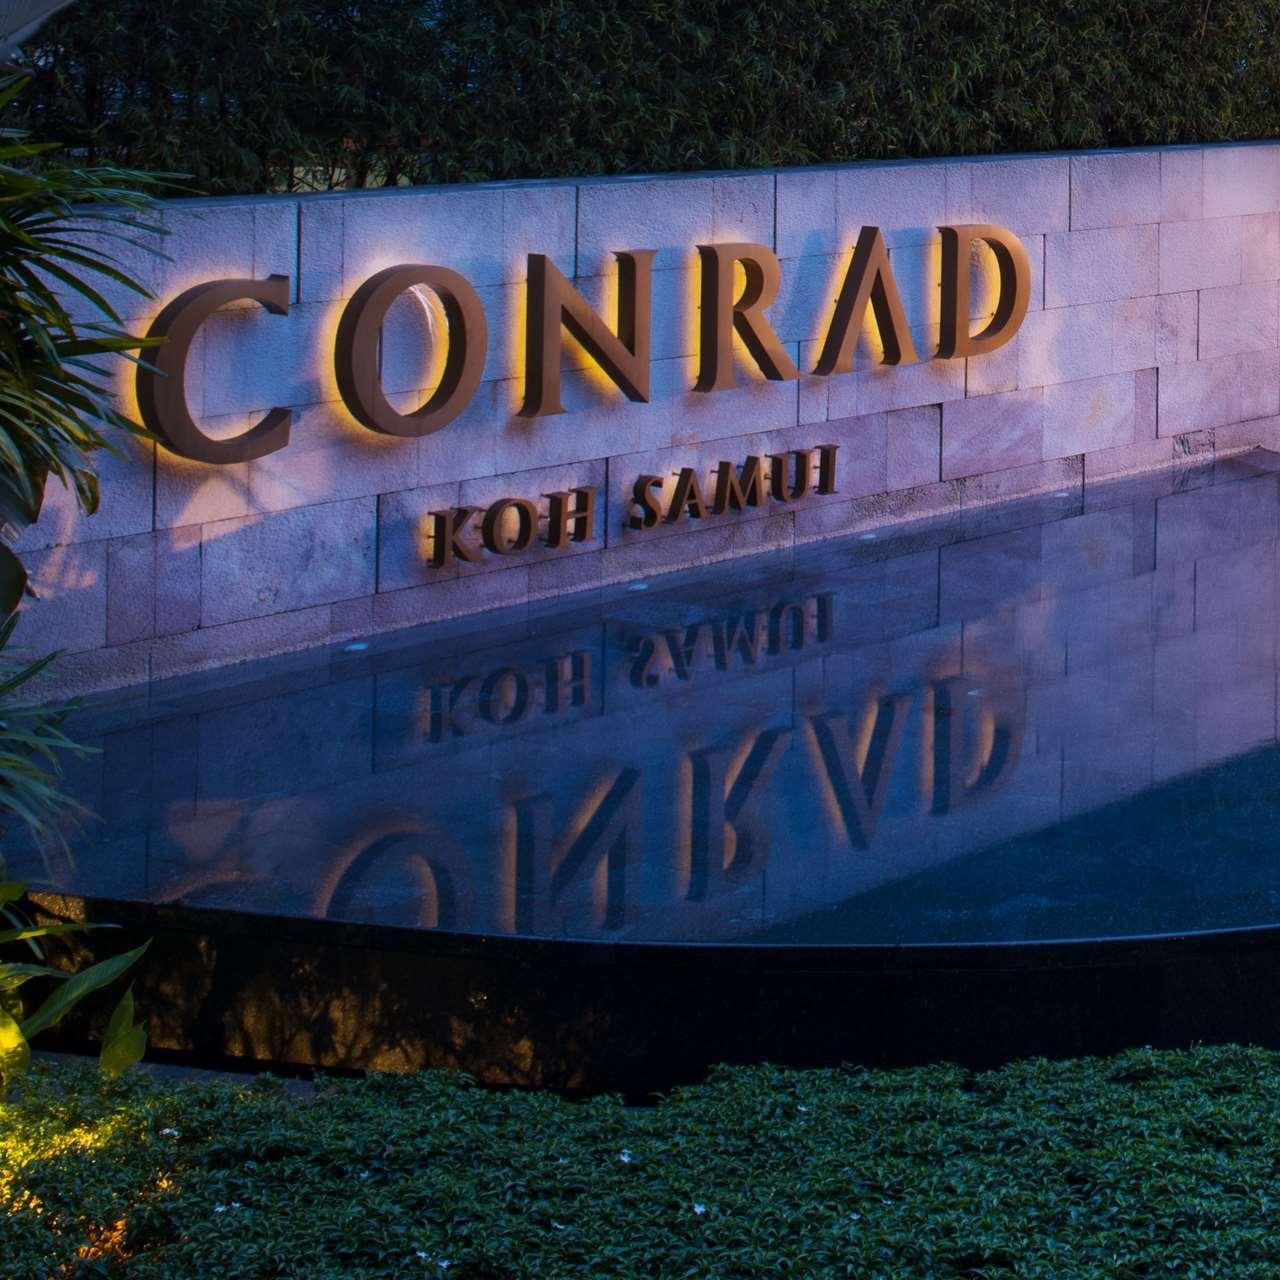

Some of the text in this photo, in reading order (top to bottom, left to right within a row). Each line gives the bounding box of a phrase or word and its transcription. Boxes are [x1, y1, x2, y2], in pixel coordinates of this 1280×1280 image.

[136, 225, 1033, 465] CONRAD
[427, 444, 841, 569] KOH SAMUI
